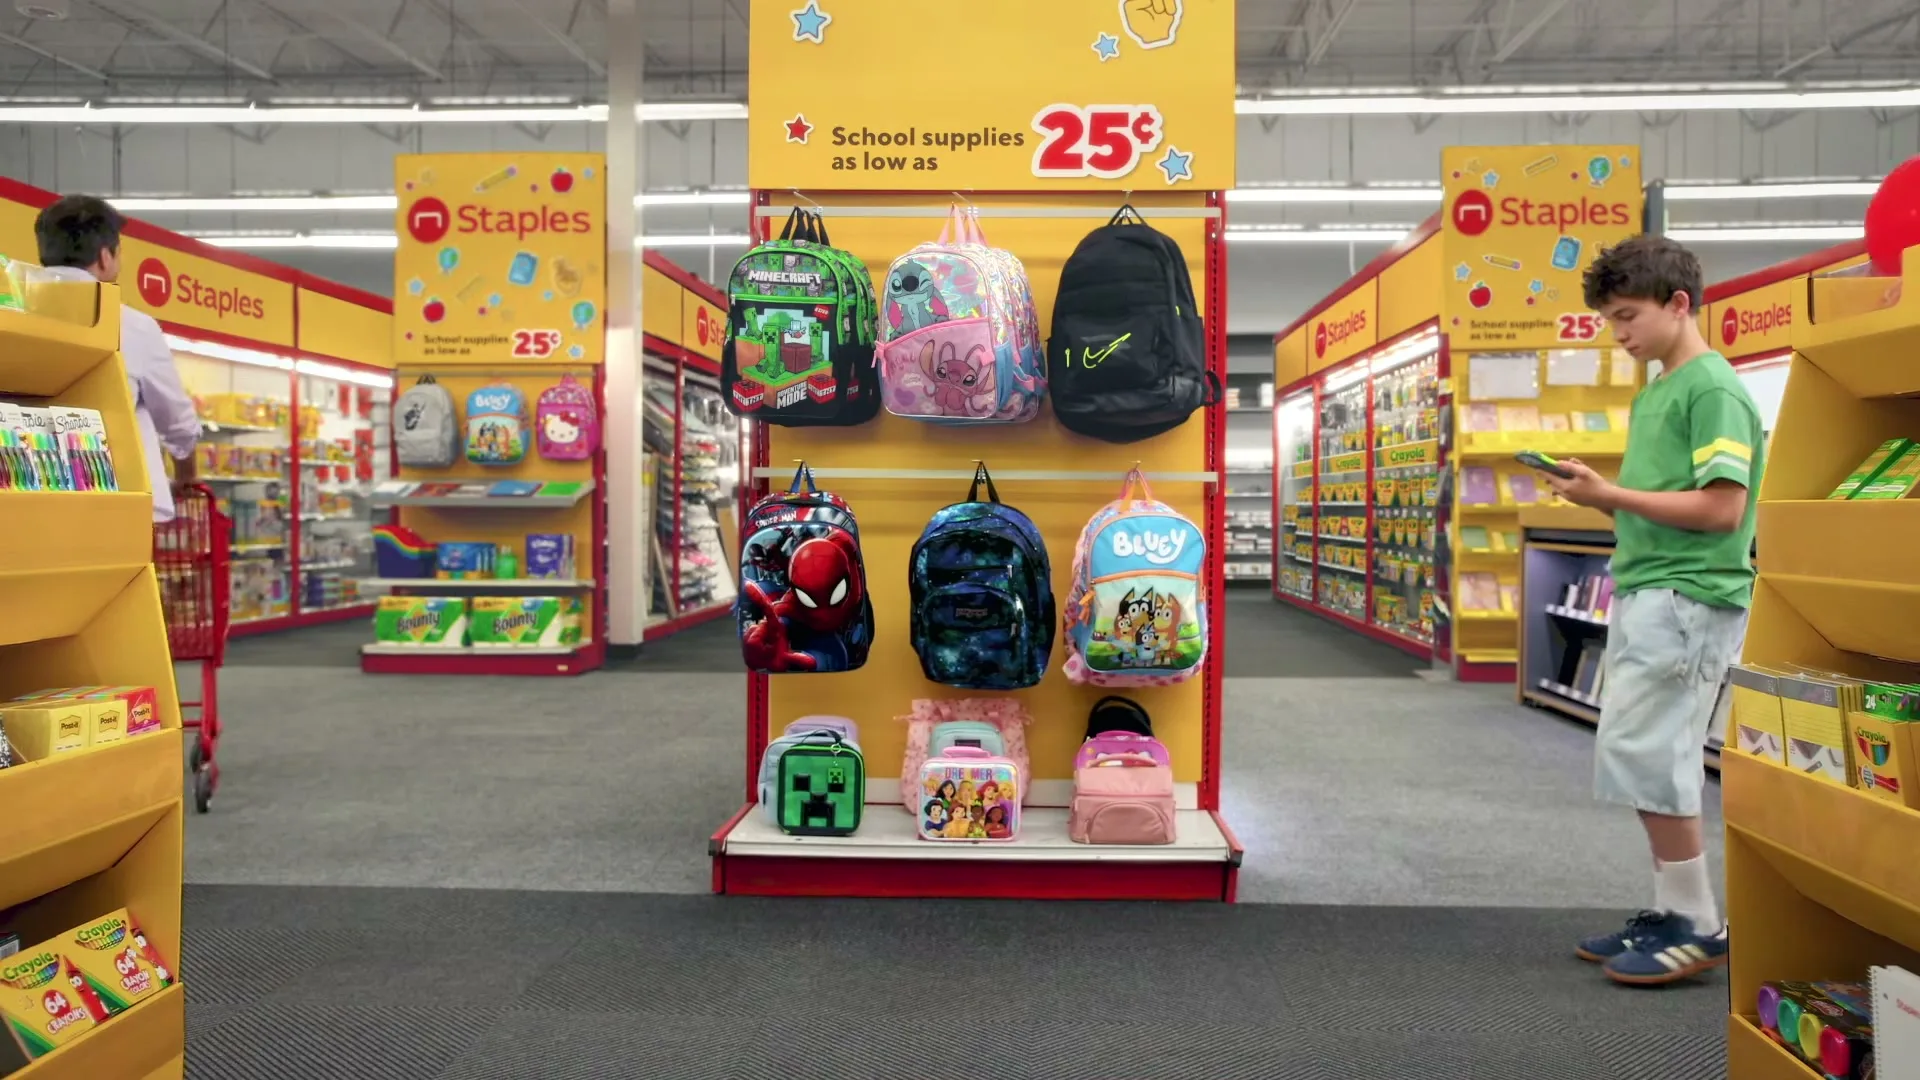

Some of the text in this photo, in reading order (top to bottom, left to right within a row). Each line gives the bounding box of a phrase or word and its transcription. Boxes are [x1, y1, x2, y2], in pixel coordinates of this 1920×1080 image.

[831, 126, 915, 147] School
[922, 126, 1025, 151] supplies
[831, 151, 938, 171] as low as
[456, 203, 592, 241] Staples
[1500, 196, 1630, 234] Staples
[748, 270, 822, 286] MINECRAFT
[176, 273, 265, 320] Staples
[1328, 308, 1367, 346] Staples
[1470, 319, 1507, 329] School
[1510, 319, 1554, 331] supplies
[1740, 303, 1792, 336] Staples
[424, 334, 461, 344] School
[464, 334, 509, 345] supplies
[776, 387, 808, 409] MODE
[55, 414, 91, 434] Sharpie
[1390, 447, 1425, 463] Crayola
[1865, 694, 1877, 710] 24
[100, 715, 118, 725] Post-it
[134, 707, 151, 718] Post-it
[61, 720, 80, 730] Post-it
[1857, 725, 1888, 744] Crayola
[945, 767, 993, 780] DREMER
[77, 917, 121, 942] Crayola
[3, 951, 54, 980] Crayola
[116, 954, 136, 975] 64
[44, 991, 68, 1014] 64
[47, 1007, 87, 1034] CRAYONS
